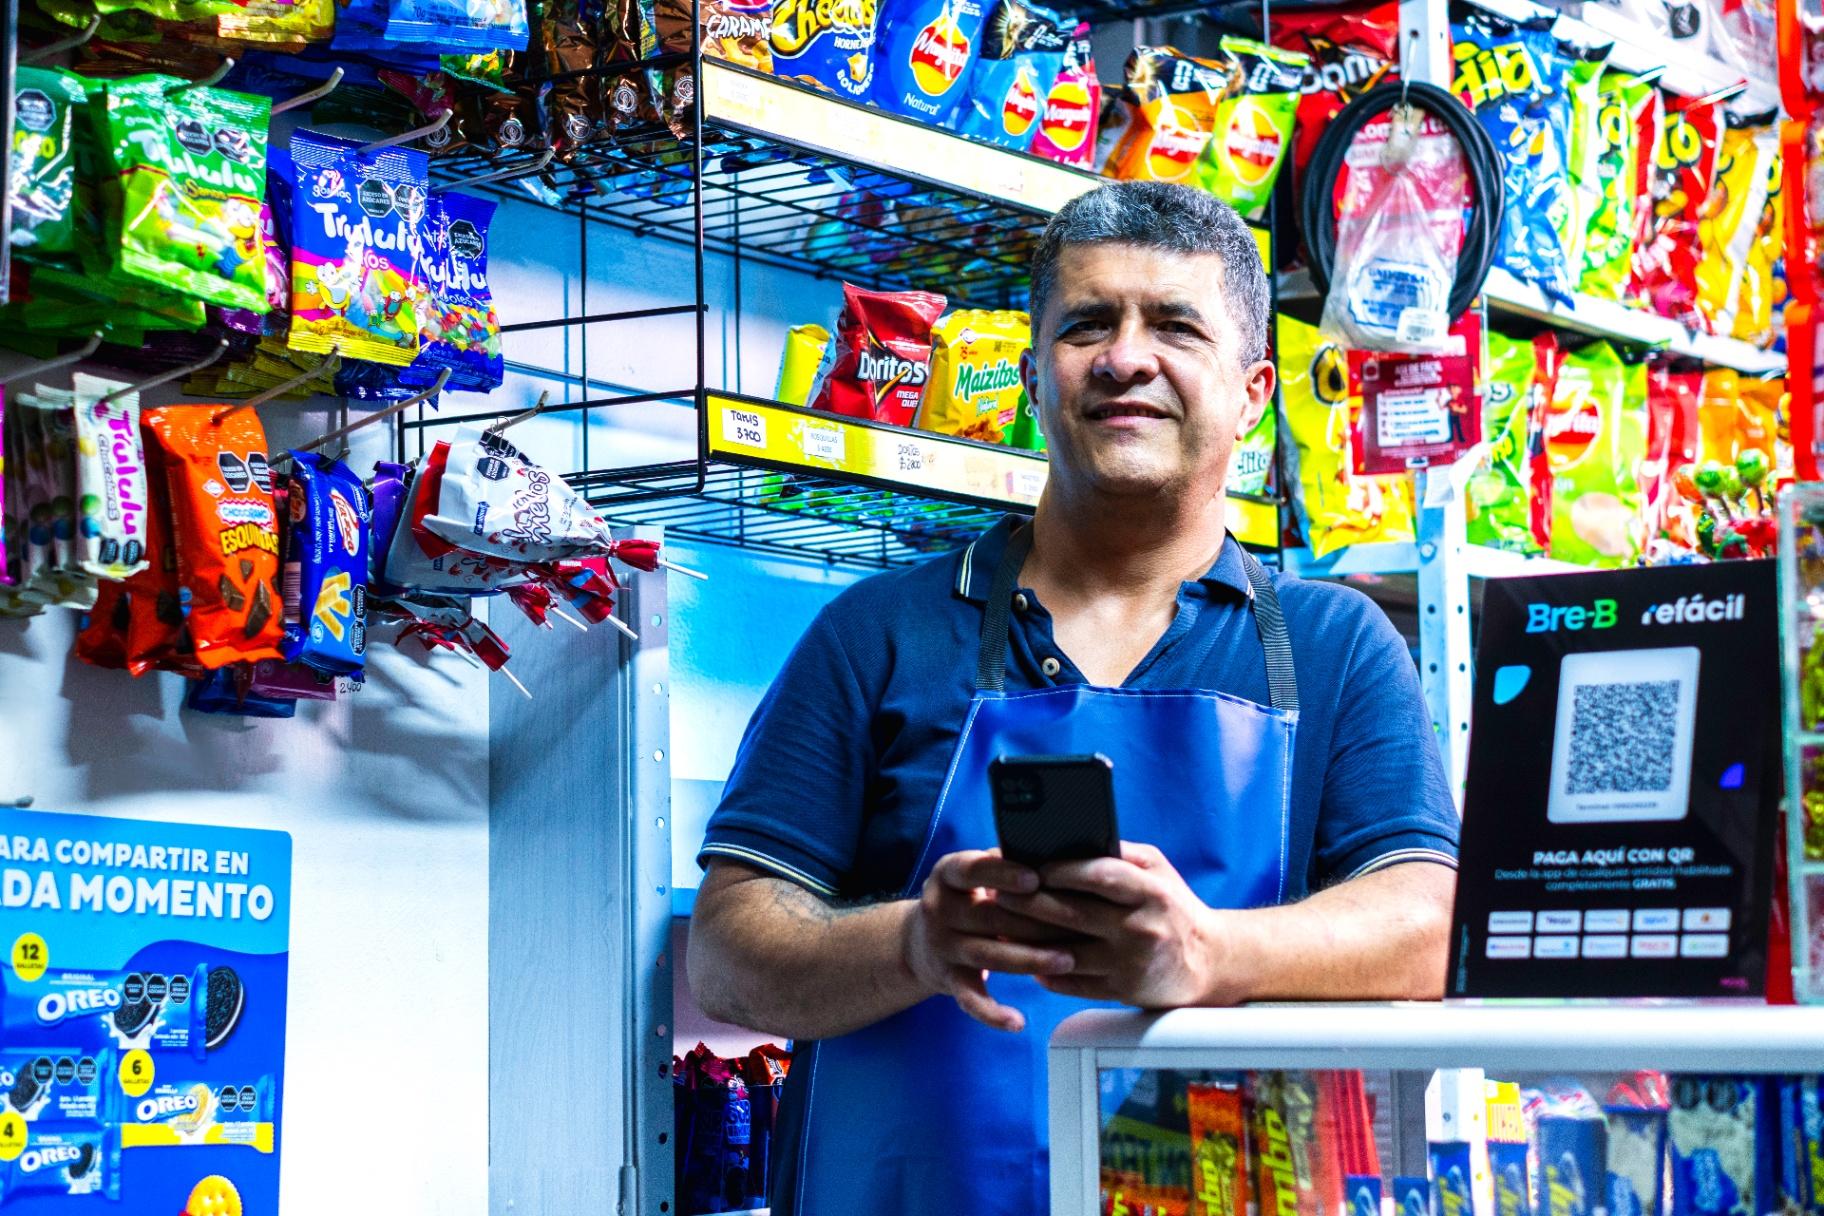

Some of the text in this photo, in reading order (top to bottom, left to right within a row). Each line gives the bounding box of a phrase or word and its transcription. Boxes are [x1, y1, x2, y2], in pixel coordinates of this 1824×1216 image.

[904, 91, 942, 116] Natural
[857, 351, 929, 385] Doritos
[956, 360, 1020, 402] Maizitos
[107, 408, 143, 536] Trululu
[1525, 594, 1746, 633] Bre-B refácil
[55, 839, 209, 874] COMPARTIR
[215, 851, 249, 875] EN
[1533, 846, 1694, 866] PAGA AQUÍ CON QR
[3, 868, 274, 920] DA MOMENTO
[22, 944, 38, 960] 12
[37, 988, 120, 1021] OREO
[132, 1060, 142, 1075] 6
[136, 1095, 198, 1121] OREO
[4, 1122, 14, 1138] 4
[20, 1146, 80, 1172] OREO
